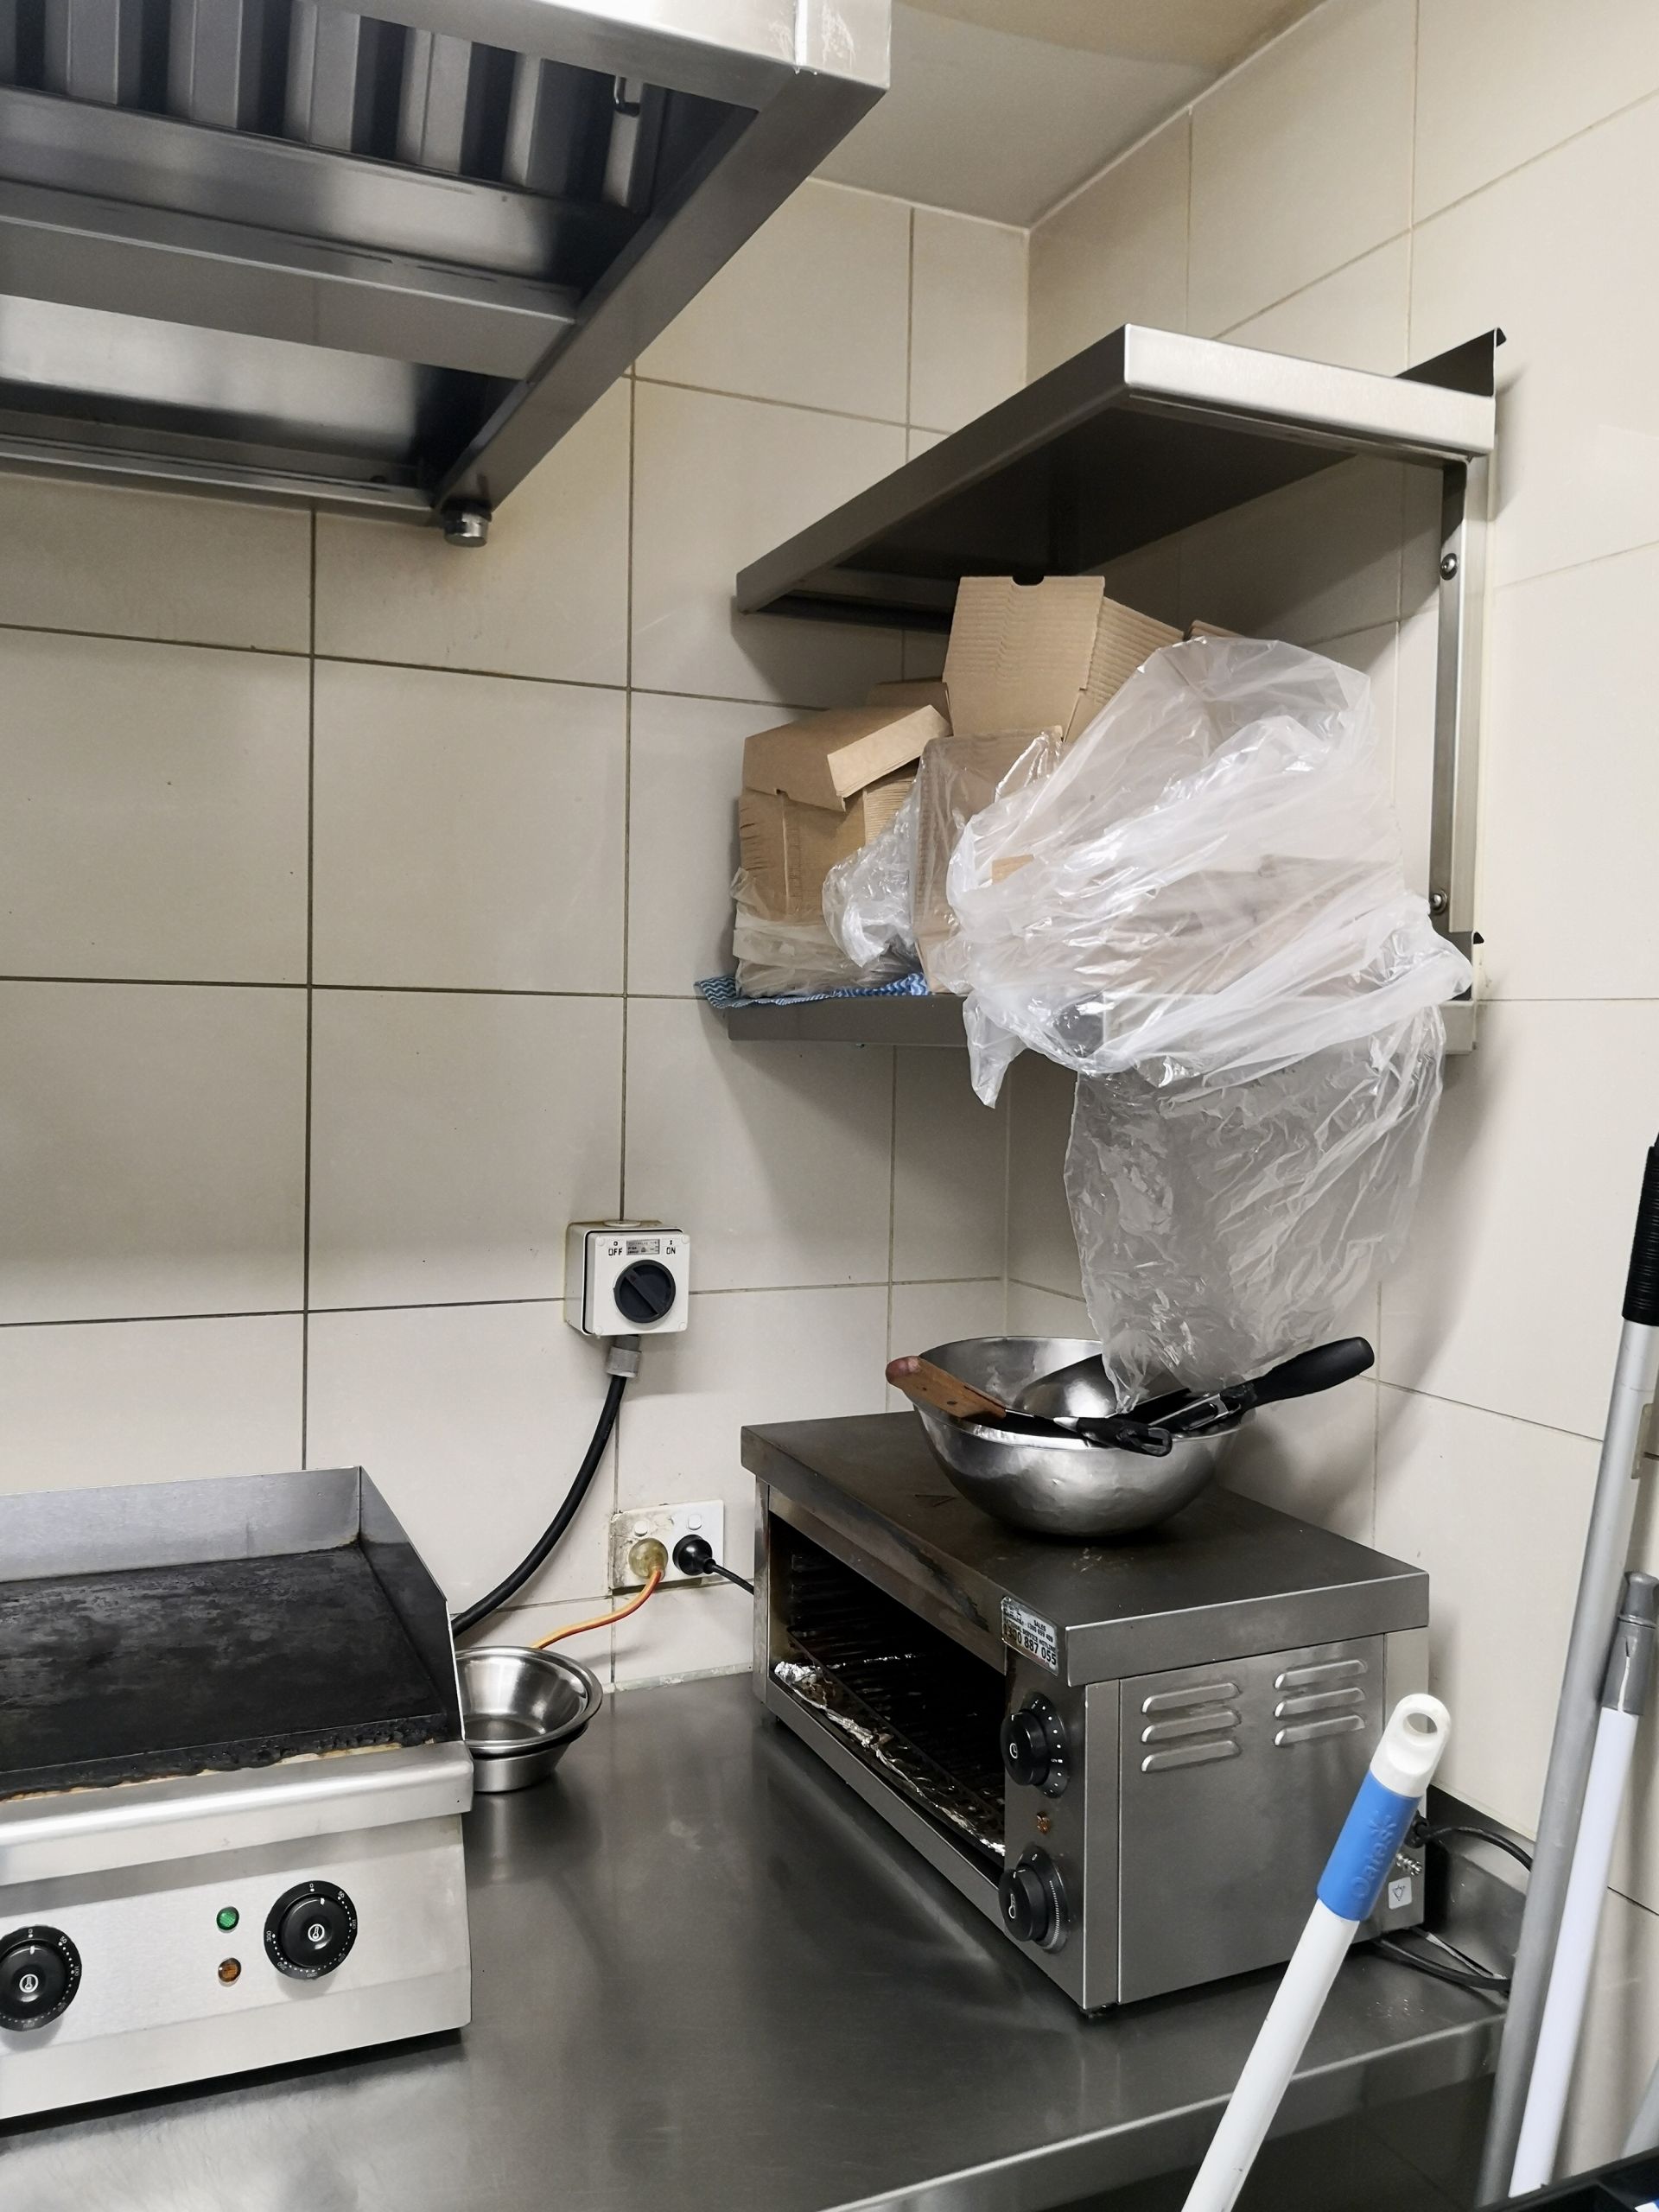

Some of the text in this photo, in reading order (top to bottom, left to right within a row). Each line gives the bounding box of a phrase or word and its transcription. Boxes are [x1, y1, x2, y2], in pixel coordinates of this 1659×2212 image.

[608, 1248, 623, 1256] OFF
[1024, 1636, 1039, 1654] 887
[1041, 1646, 1057, 1666] 055
